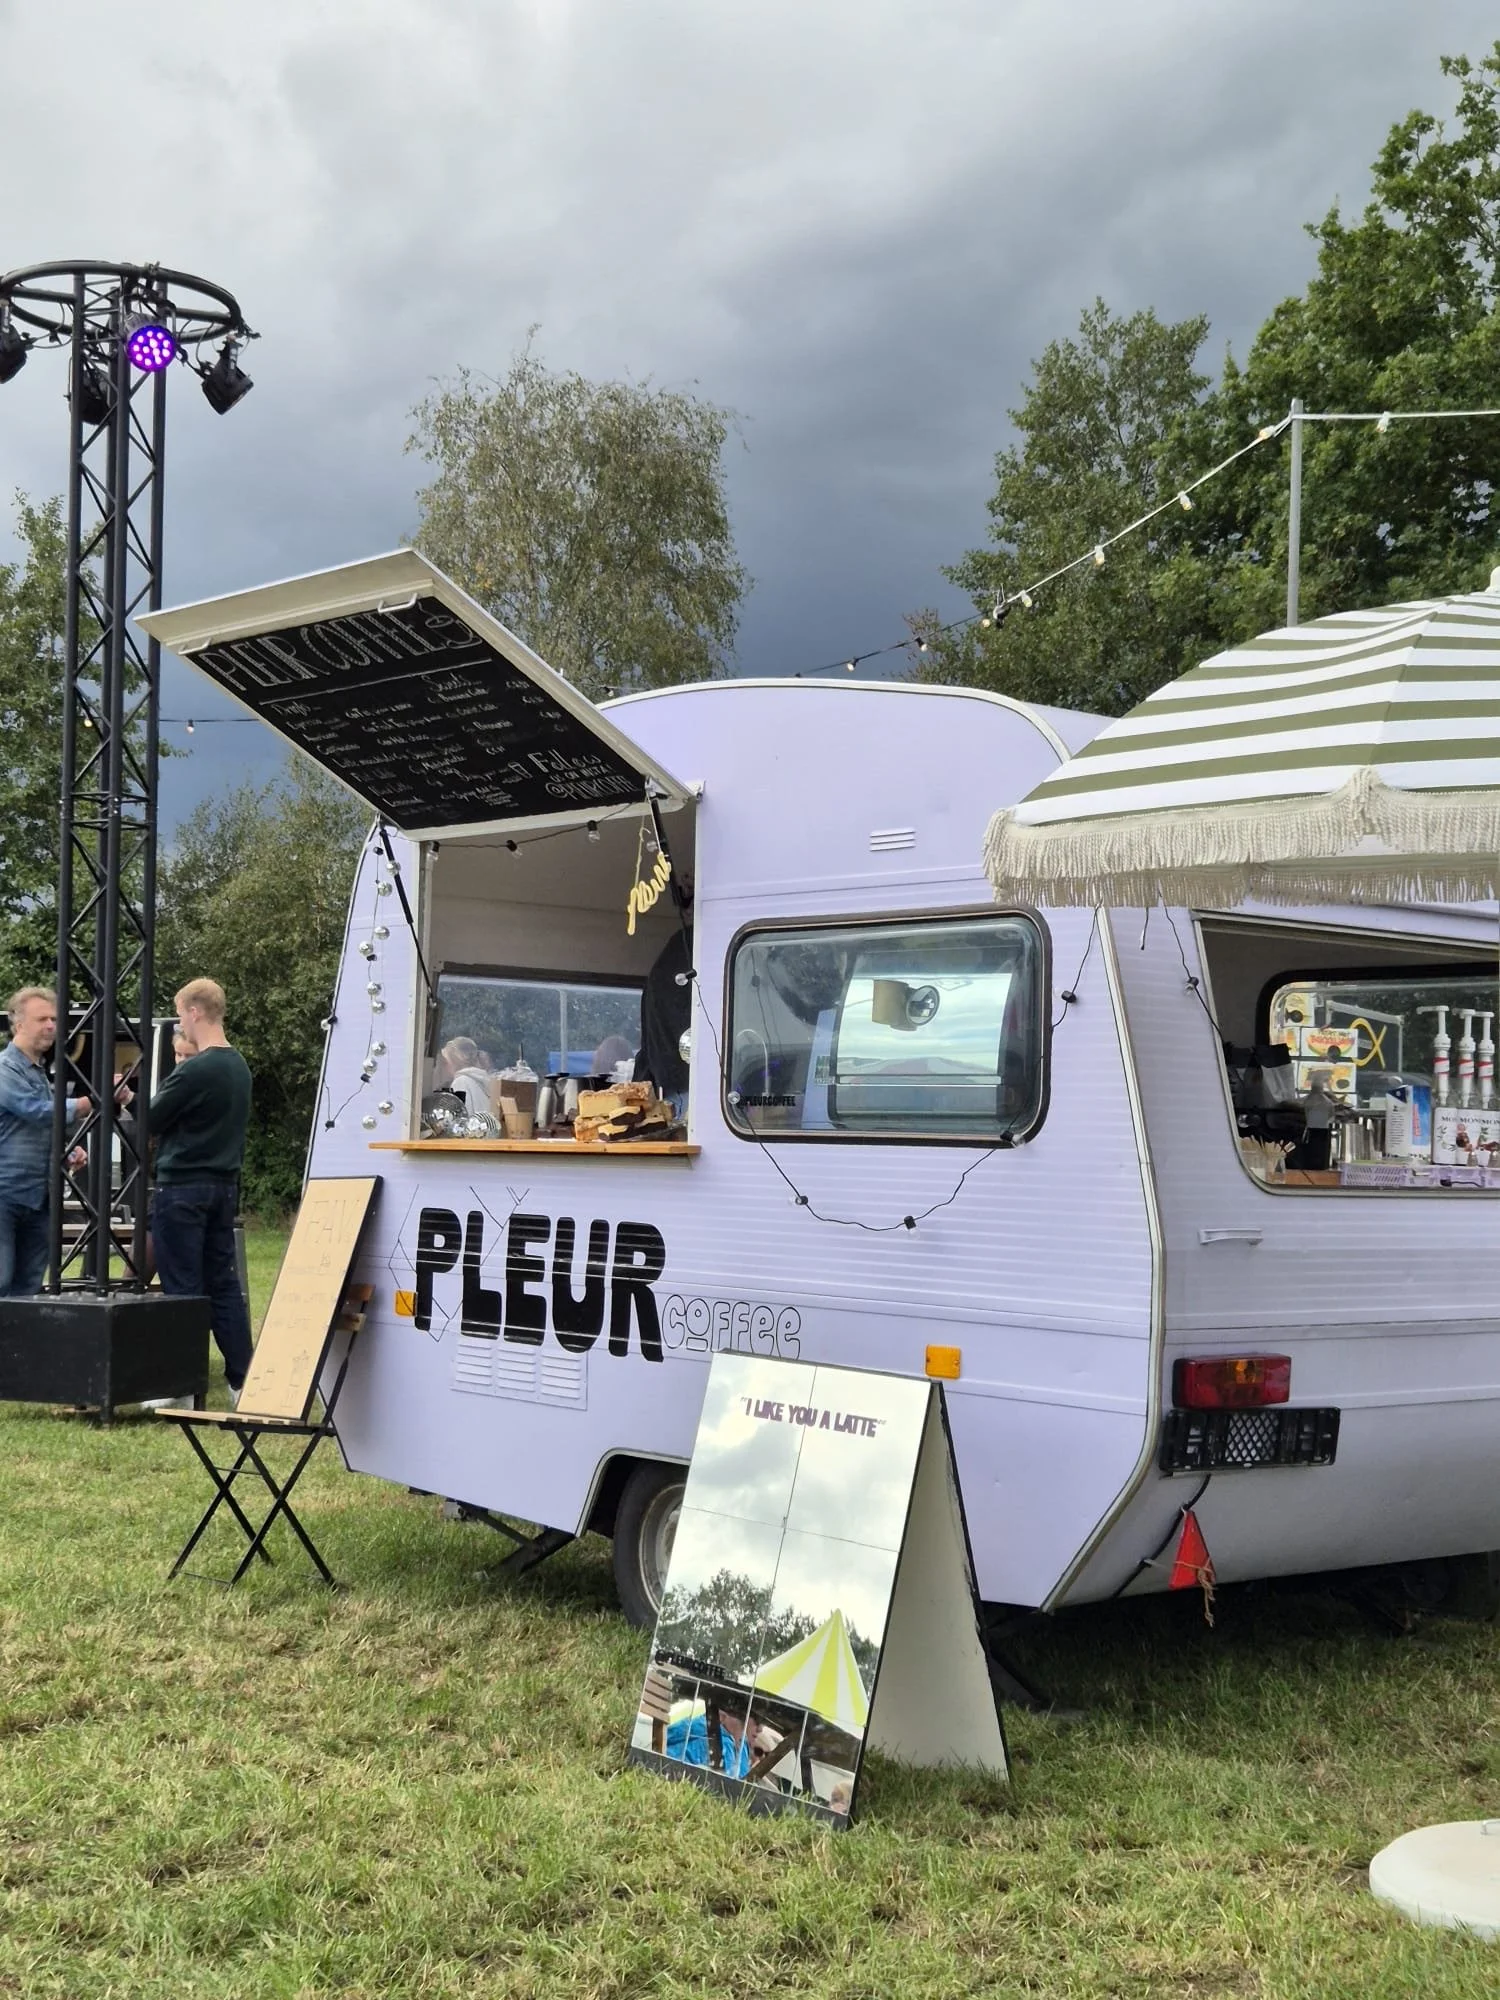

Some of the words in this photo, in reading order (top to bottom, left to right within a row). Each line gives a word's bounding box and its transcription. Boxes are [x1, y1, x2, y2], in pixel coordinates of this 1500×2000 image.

[198, 635, 330, 692] PLEUR
[300, 611, 447, 670] COFFEE
[527, 748, 602, 773] Follow
[414, 1207, 665, 1363] PLEUR
[753, 1399, 785, 1422] LIKE
[788, 1403, 819, 1427] YOU
[819, 1409, 831, 1430] A
